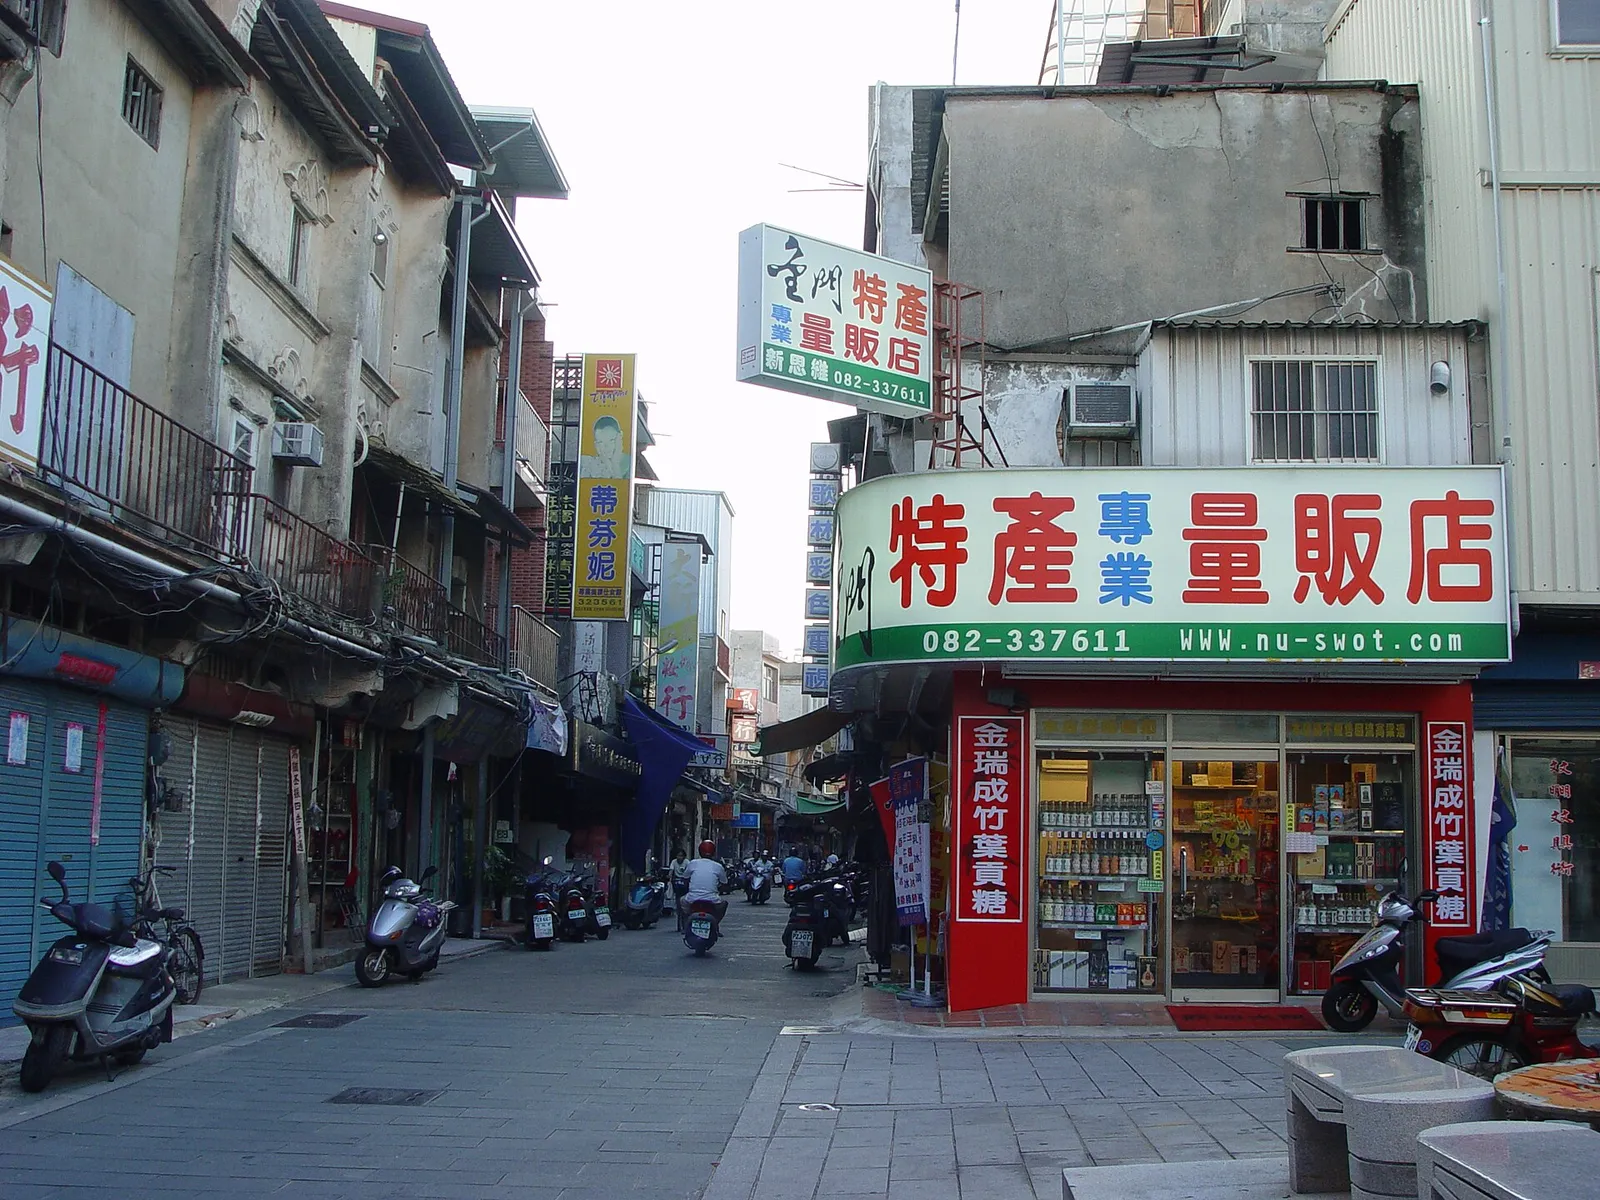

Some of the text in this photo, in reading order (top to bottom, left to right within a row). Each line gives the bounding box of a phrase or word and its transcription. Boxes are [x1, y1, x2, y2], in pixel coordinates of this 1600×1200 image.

[770, 303, 793, 345] 專業
[799, 312, 923, 376] 量販店
[852, 268, 929, 337] 特產
[765, 347, 829, 383] 新思維
[833, 370, 926, 405] 082-337611
[587, 484, 618, 582] 蒂芬妮
[889, 490, 1078, 609] 特產
[1098, 490, 1154, 606] 專業
[1181, 490, 1494, 606] 量販店
[805, 483, 837, 689] 歌林彩色電視
[922, 628, 1131, 655] 082-337611
[660, 685, 693, 720] 行
[972, 721, 1009, 915] 金瑞成竹葉貢糖
[1432, 728, 1465, 920] 金瑞成竹葉貢糖
[1553, 760, 1575, 876] 文明文具行
